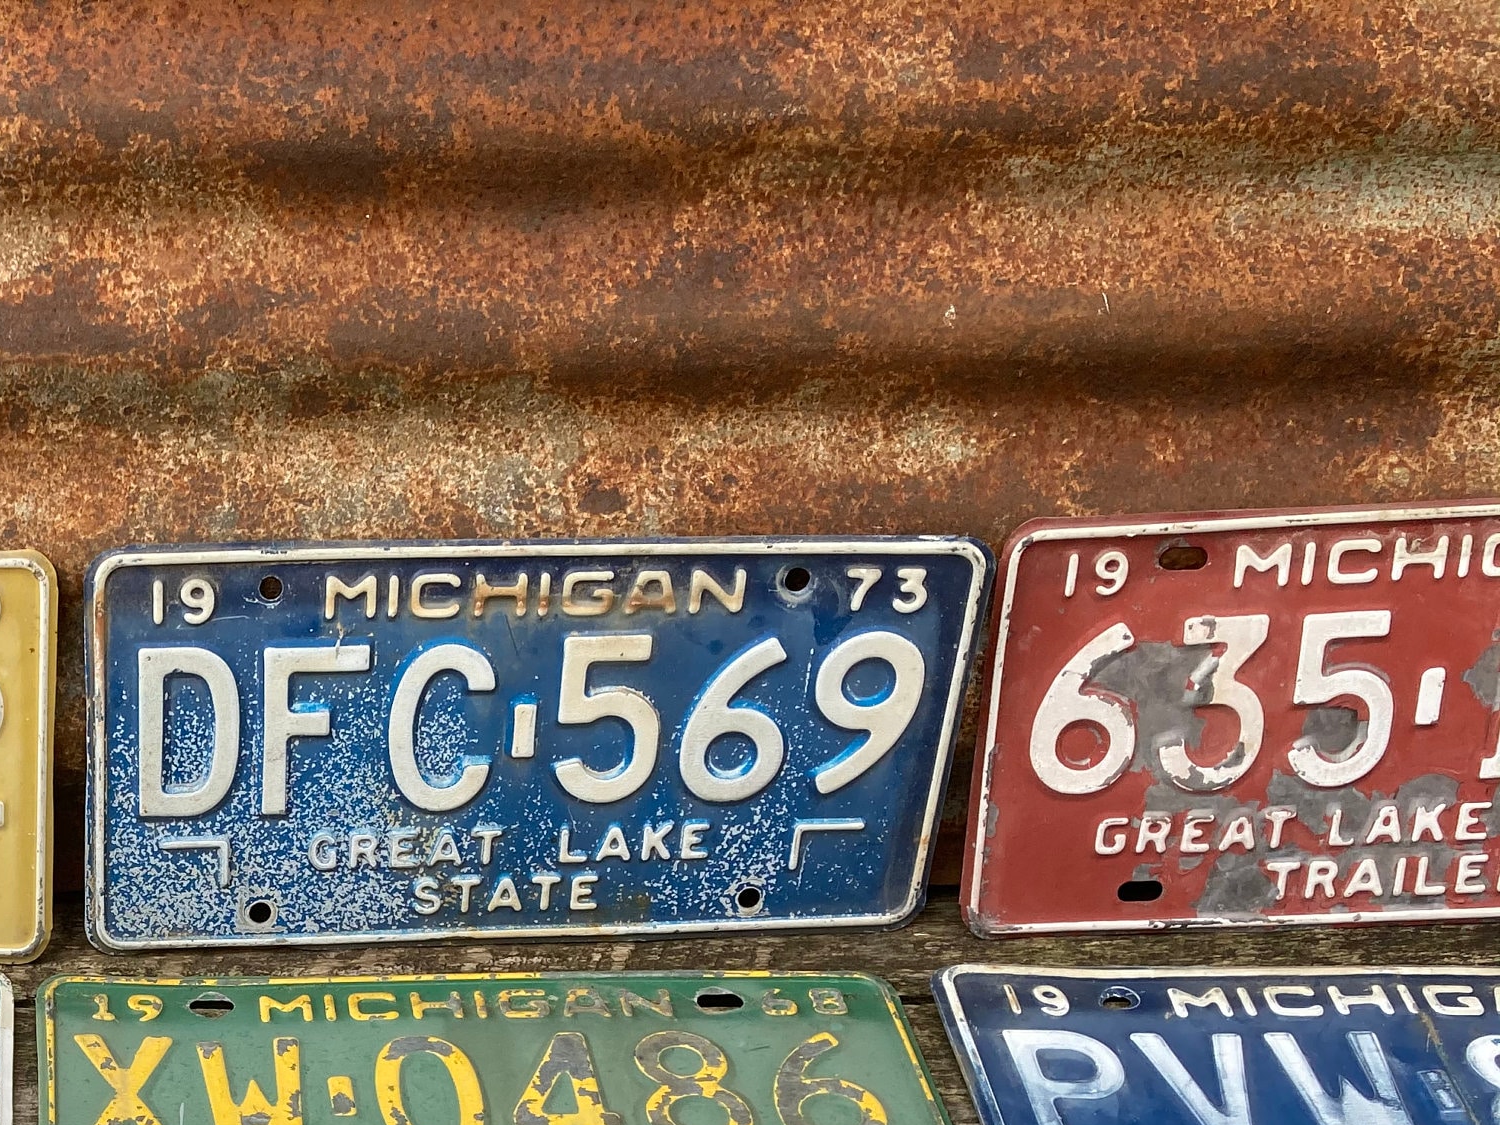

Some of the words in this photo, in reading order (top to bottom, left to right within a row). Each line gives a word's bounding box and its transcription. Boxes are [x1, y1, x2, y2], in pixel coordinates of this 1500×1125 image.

[151, 577, 216, 625] 19
[324, 568, 748, 620] MICHIGAN
[847, 565, 929, 615] 73
[1063, 551, 1130, 598] 19
[1028, 609, 1500, 795] 635-
[307, 827, 505, 871] GREAT
[559, 820, 710, 865] LAKE
[1094, 808, 1297, 855] GREAT
[1328, 801, 1493, 847] LAKE
[412, 875, 599, 916] STATE
[91, 993, 161, 1023] 19
[259, 988, 673, 1023] MICHIGAN
[762, 987, 848, 1018] 68
[1003, 984, 1069, 1016] 19
